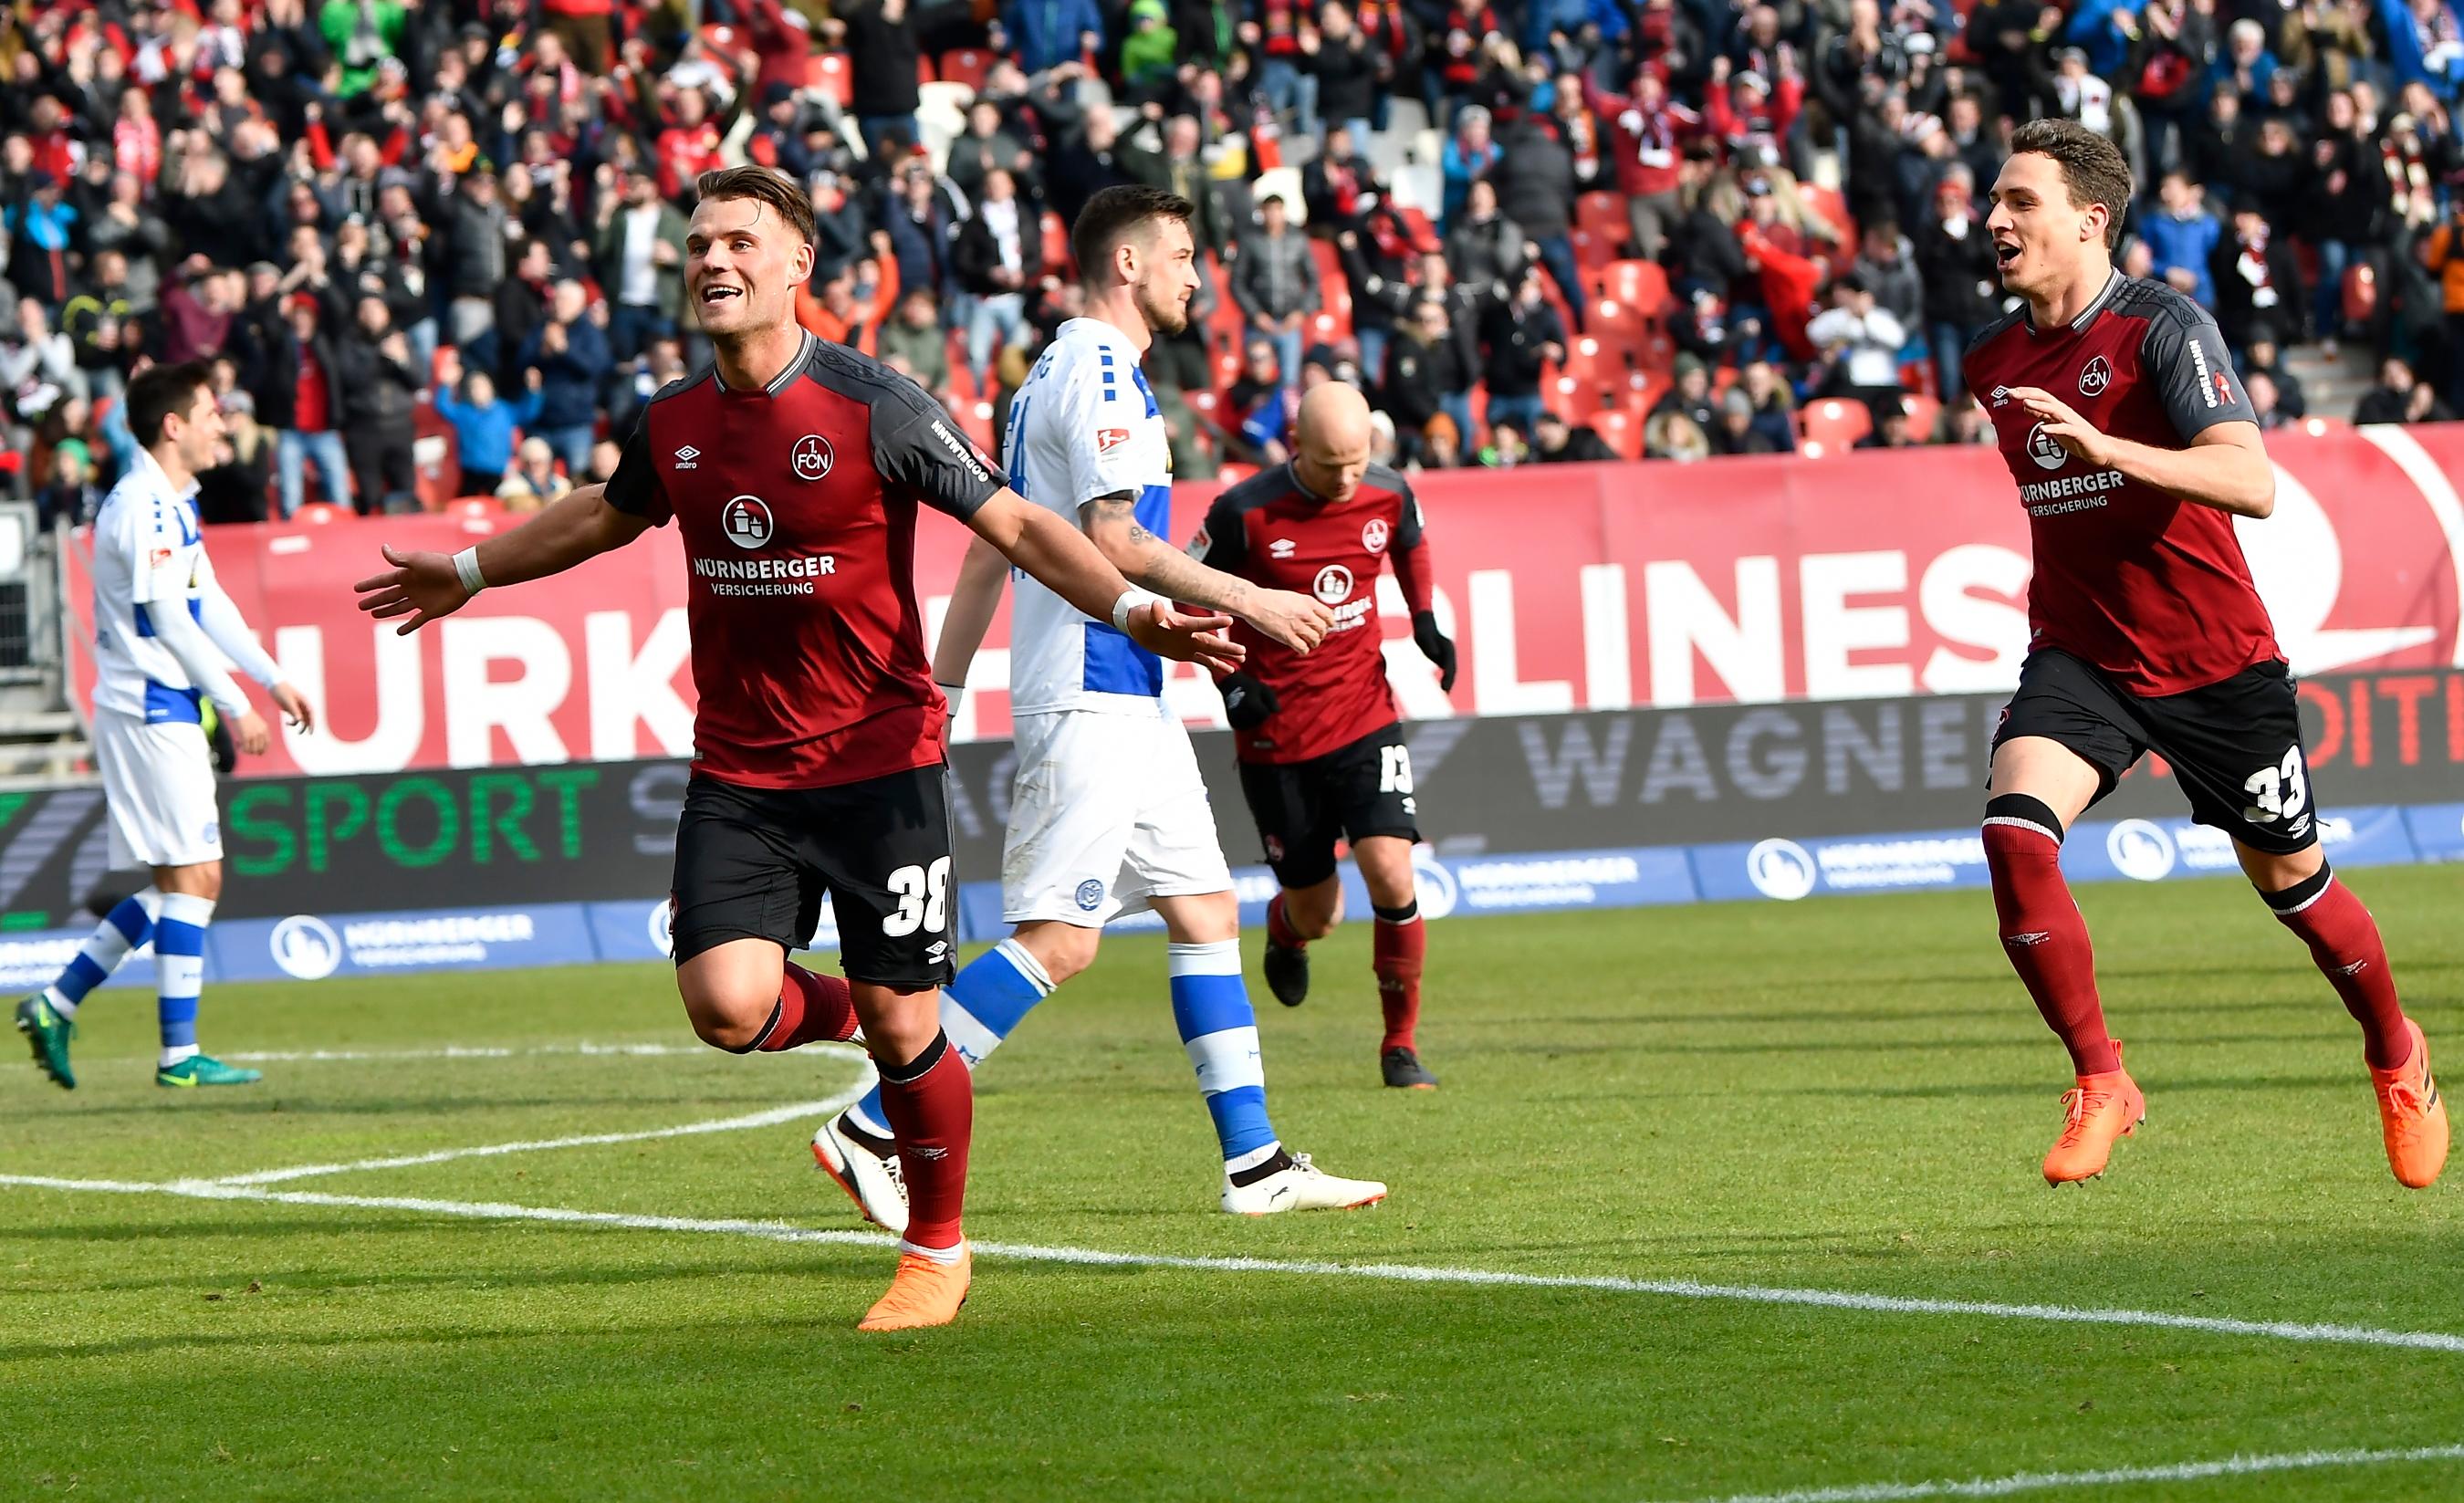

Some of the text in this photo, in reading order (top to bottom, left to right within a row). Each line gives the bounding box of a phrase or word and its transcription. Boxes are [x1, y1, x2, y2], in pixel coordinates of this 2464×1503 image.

[2082, 371, 2106, 389] FCN
[674, 461, 697, 470] umbro
[797, 454, 829, 470] FCN
[694, 555, 836, 579] NÜRNBERGER
[711, 581, 814, 596] VERSICHERUNG
[1379, 744, 1414, 795] 13
[2243, 744, 2307, 823] 33
[228, 769, 600, 876] SPORT
[882, 855, 952, 937] 38
